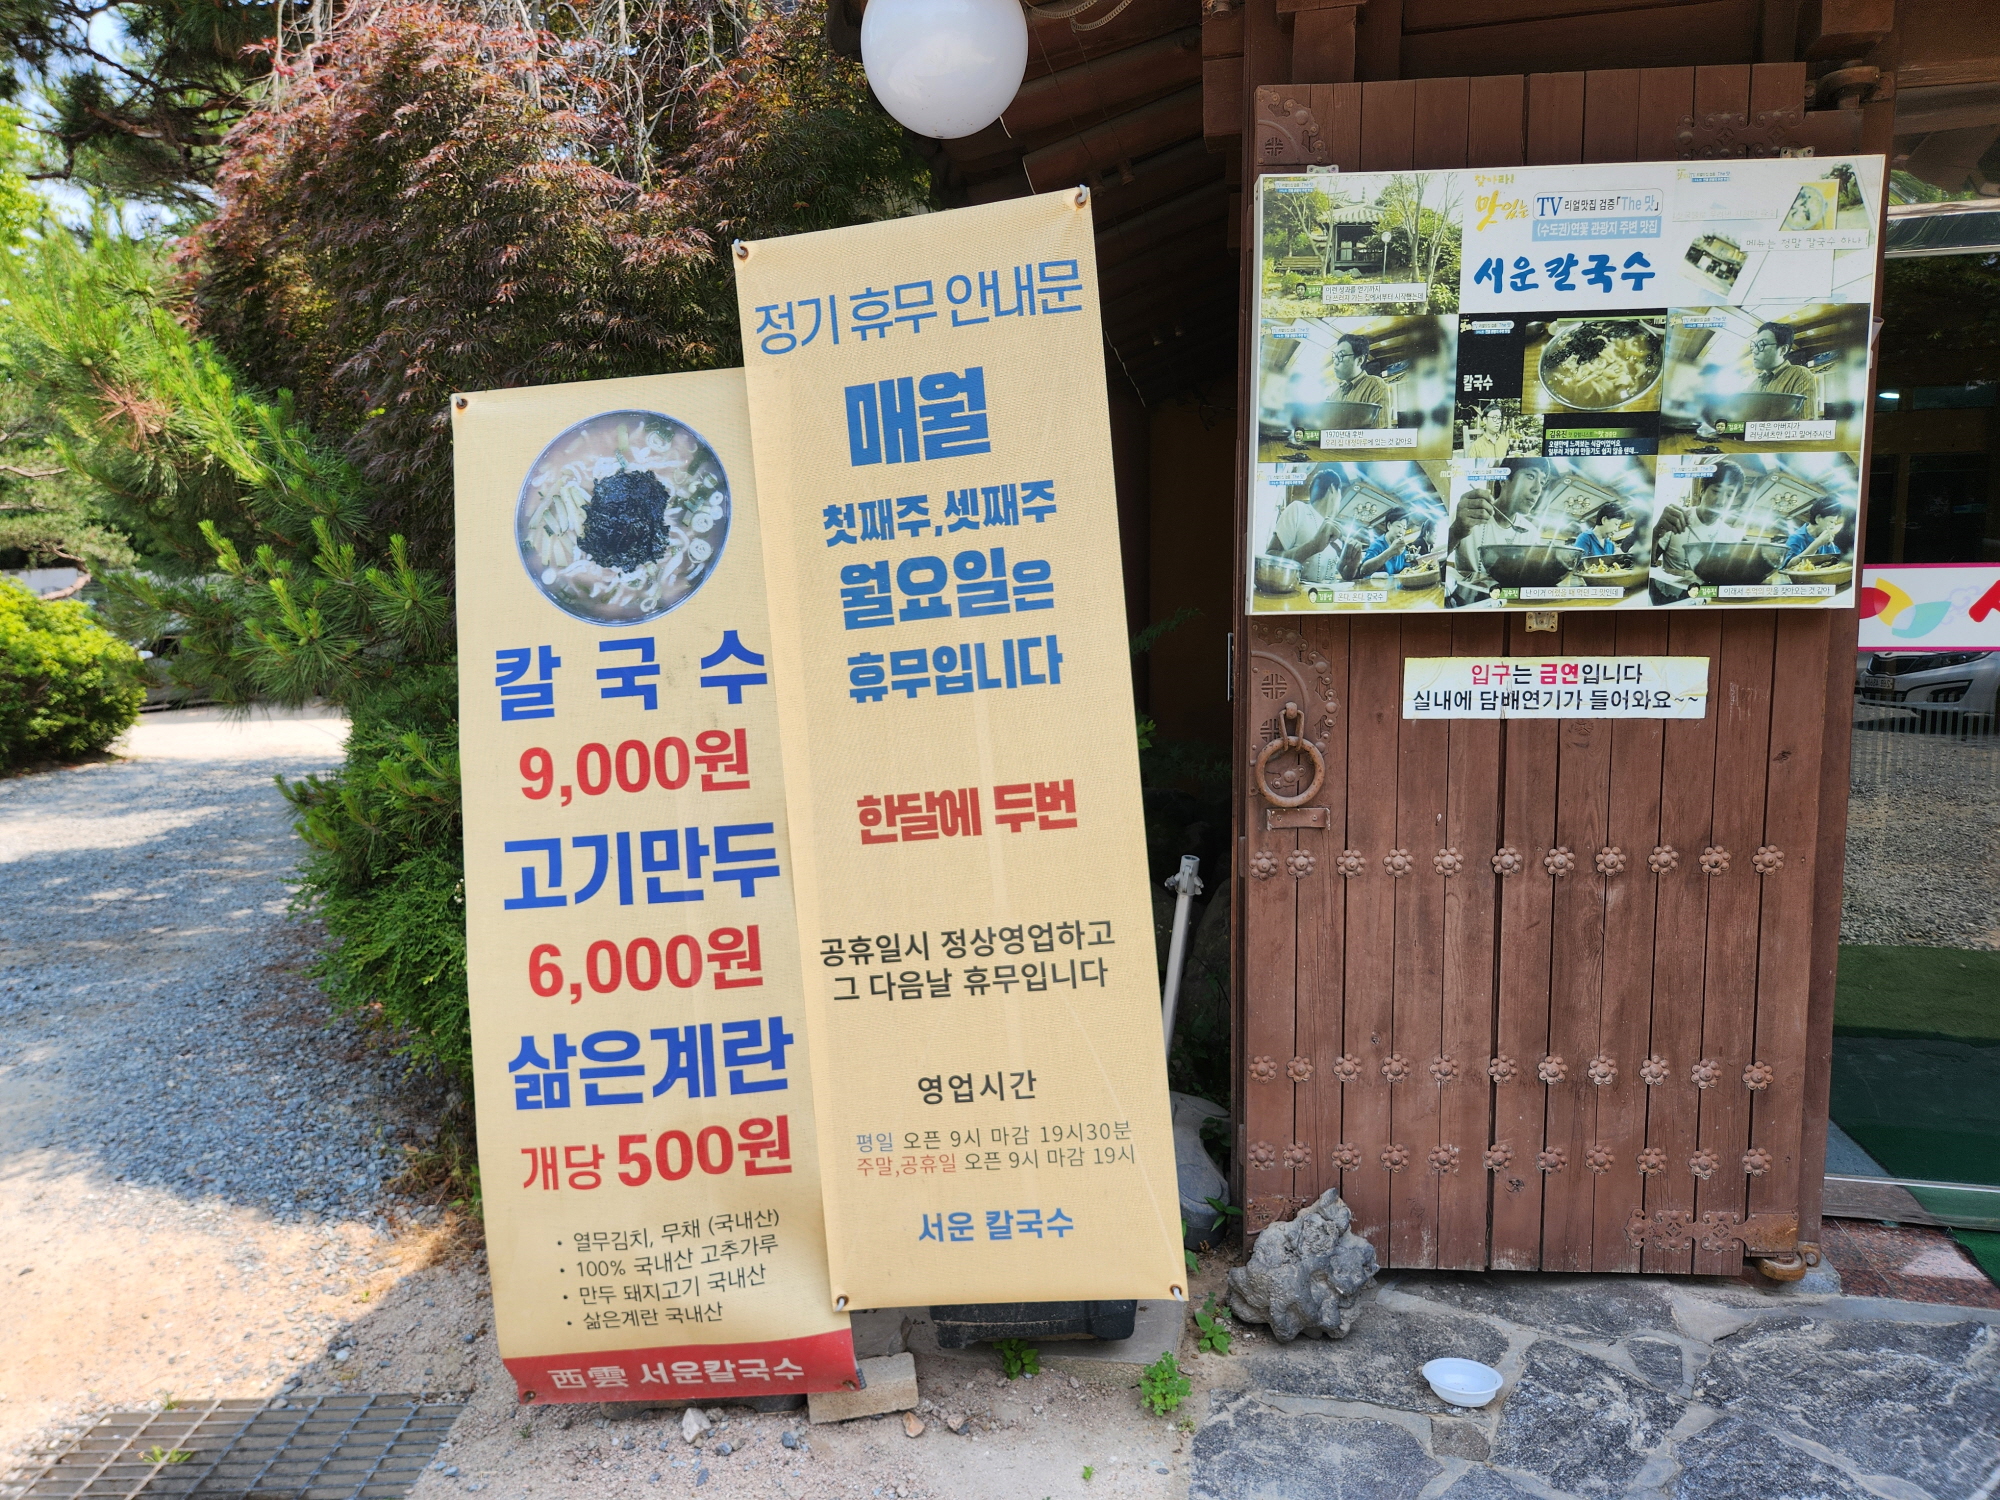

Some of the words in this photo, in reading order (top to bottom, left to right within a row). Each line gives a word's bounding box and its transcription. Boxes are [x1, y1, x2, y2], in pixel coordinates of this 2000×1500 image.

[1537, 197, 1563, 216] TV
[1564, 199, 1597, 212] 리얼맛집
[1591, 221, 1617, 235] 관광지
[1619, 221, 1638, 235] 주변
[1640, 220, 1658, 234] 맛집
[1745, 238, 1775, 250] 메뉴는
[1781, 238, 1802, 249] 정말
[1806, 236, 1836, 248] 칼국수
[1325, 285, 1338, 295] 이런
[1364, 293, 1392, 301] 집에서부터
[755, 293, 840, 356] 정기
[849, 279, 938, 342] 휴무
[946, 259, 1083, 328] 안내문
[1462, 374, 1493, 391] 칼국수
[844, 366, 991, 467] 매월
[1750, 423, 1757, 431] 이
[1773, 422, 1801, 430] 아버지가
[1325, 430, 1351, 438] 1970년대
[1352, 430, 1363, 438] 후반
[1325, 439, 1337, 447] 우리
[1338, 439, 1344, 447] 집
[1345, 438, 1373, 447] 대청마루에
[1374, 438, 1386, 446] 있는
[1387, 438, 1393, 446] 것
[1395, 437, 1412, 445] 같아요
[1549, 430, 1567, 438] 김유진
[1784, 430, 1797, 438] 입고
[1799, 430, 1832, 439] 밀어주시던
[1580, 447, 1601, 455] 만들기도
[823, 479, 1057, 548] 첫째주,셋째주
[840, 546, 1054, 630] 월요일은
[1366, 592, 1384, 601] 칼국수
[1525, 589, 1532, 597] 난
[1533, 589, 1546, 597] 이거
[1576, 588, 1590, 597] 먹던
[1599, 588, 1618, 597] 맛인데
[1723, 587, 1743, 596] 이래서
[1744, 587, 1764, 595] 추억의
[1766, 587, 1778, 595] 맛을
[1780, 586, 1808, 595] 찾아오는
[1808, 586, 1815, 594] 것
[1816, 586, 1830, 594] 같아
[847, 634, 1063, 704] 휴무입니다
[1472, 664, 1533, 685] 입구는
[1540, 662, 1643, 685] 금연입니다
[1412, 689, 1473, 711] 실내에
[1480, 689, 1583, 711] 담배연기가
[519, 728, 751, 807] 9,000원
[856, 787, 982, 845] 한달에
[993, 778, 1078, 833] 두번
[504, 822, 780, 911] 고기만두
[820, 931, 930, 967] 공휴일시
[940, 919, 1116, 960] 정상영업하고
[528, 924, 763, 1005] 6,000원
[833, 976, 860, 1001] 그
[870, 967, 953, 1002] 다음날
[963, 956, 1108, 997] 휴무입니다
[508, 1015, 794, 1111] 삶은계란
[917, 1069, 1037, 1106] 영업시간
[520, 1144, 605, 1190] 개당
[618, 1114, 792, 1187] 500원
[856, 1132, 894, 1154] 평일
[903, 1130, 941, 1150] 오픈
[950, 1127, 981, 1148] 9시
[991, 1125, 1030, 1147] 마감
[1040, 1120, 1132, 1144] 19시30분
[856, 1153, 957, 1177] 주말,공휴일
[964, 1151, 1002, 1171] 오픈
[1009, 1149, 1039, 1170] 9시
[1047, 1147, 1085, 1168] 마감
[1093, 1144, 1136, 1166] 19시
[573, 1227, 654, 1252] 열무김치,
[661, 1218, 701, 1244] 무채
[708, 1208, 781, 1236] (국내산)
[919, 1212, 974, 1243] 서운
[985, 1207, 1074, 1241] 칼국수
[576, 1259, 626, 1277] 100%
[633, 1247, 693, 1277] 국내산
[700, 1233, 779, 1265] 고추가루
[579, 1285, 617, 1305] 만두
[623, 1275, 700, 1303] 돼지고기
[707, 1263, 767, 1293] 국내산
[583, 1308, 659, 1331] 삶은계란
[664, 1301, 724, 1325] 국내산
[547, 1365, 630, 1390] 西雲
[640, 1357, 805, 1385] 서운칼국수
